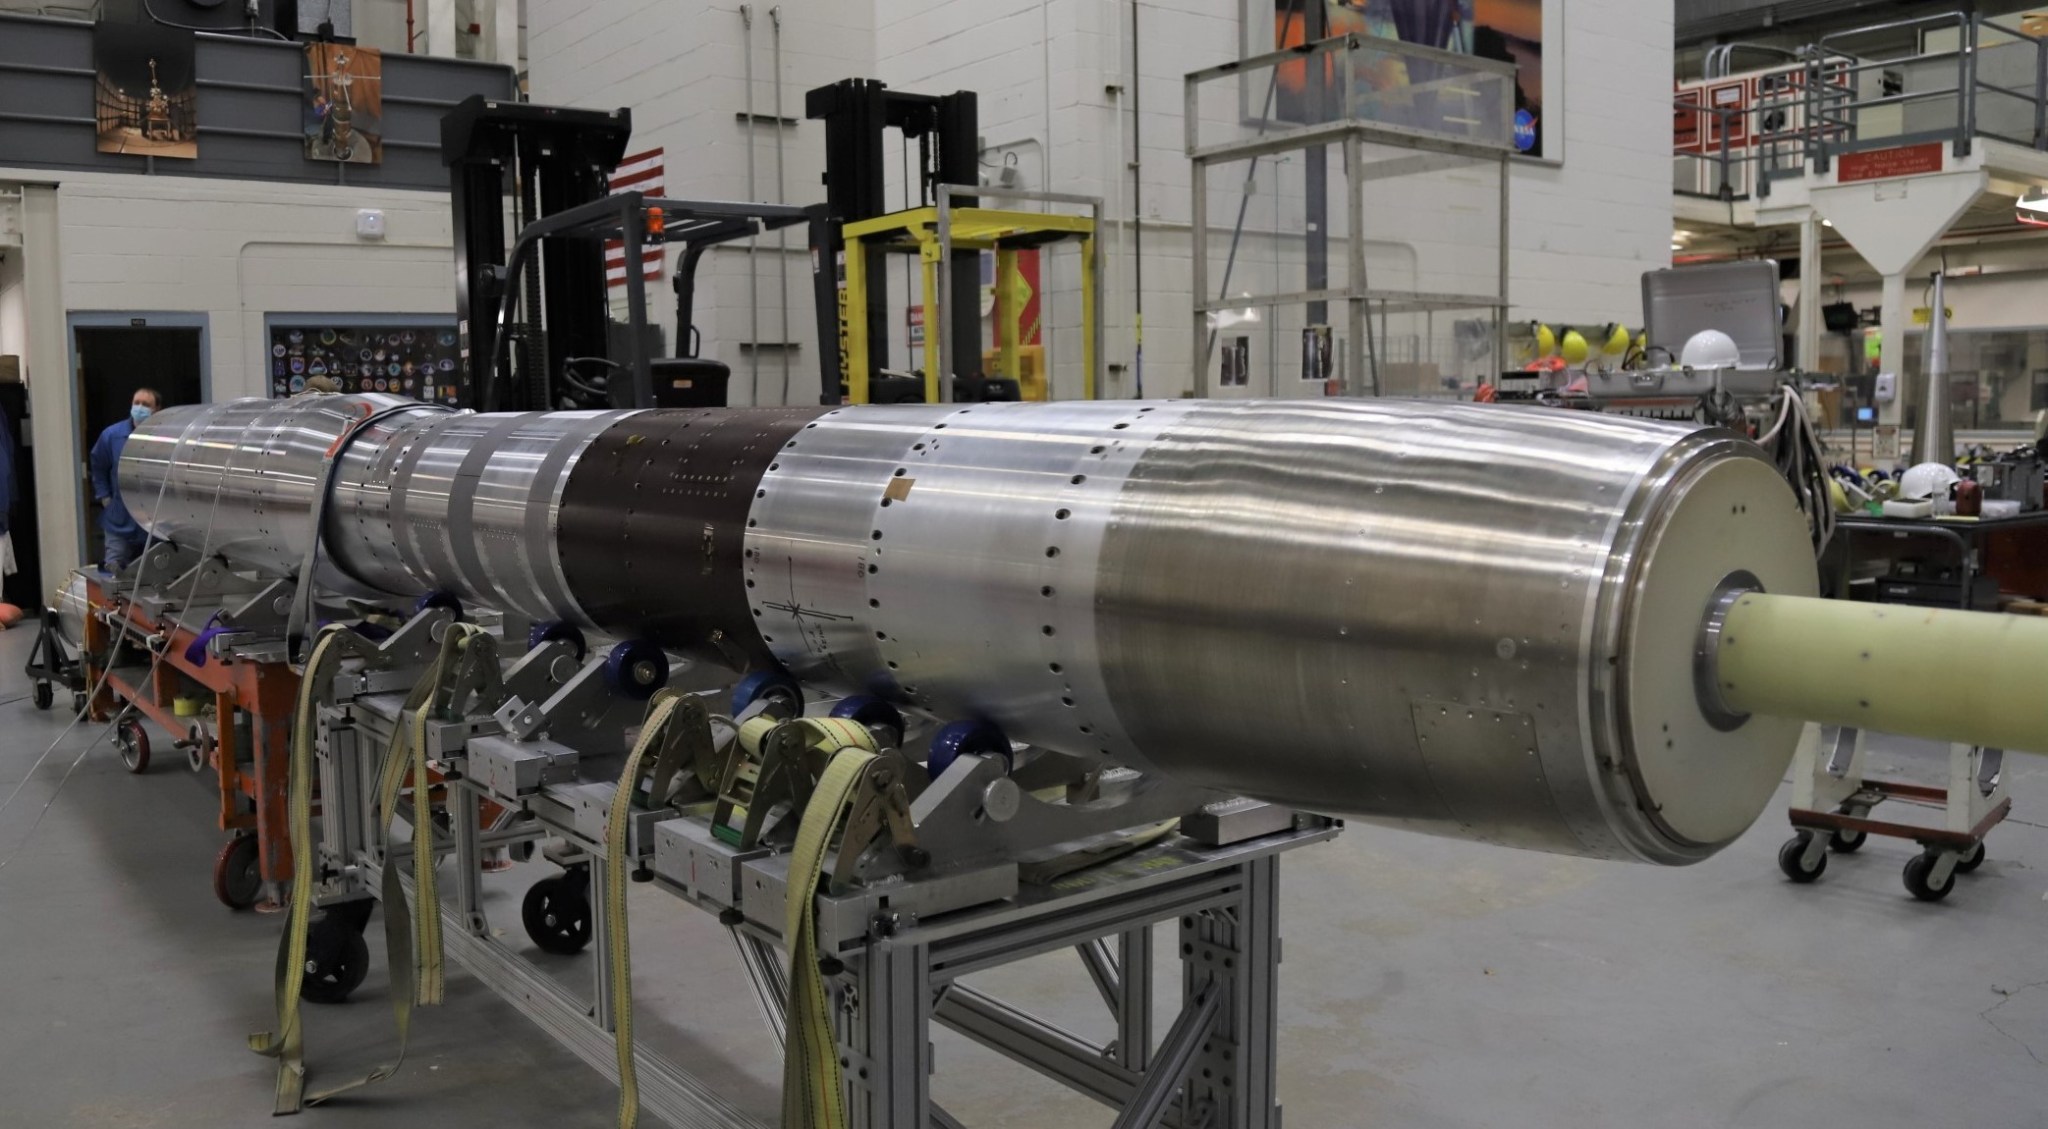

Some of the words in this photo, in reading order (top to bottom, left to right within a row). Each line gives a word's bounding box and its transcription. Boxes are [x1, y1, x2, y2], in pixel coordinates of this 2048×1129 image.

[1864, 149, 1914, 161] CAUTION
[838, 289, 850, 386] HYSTER
[857, 556, 865, 578] 180
